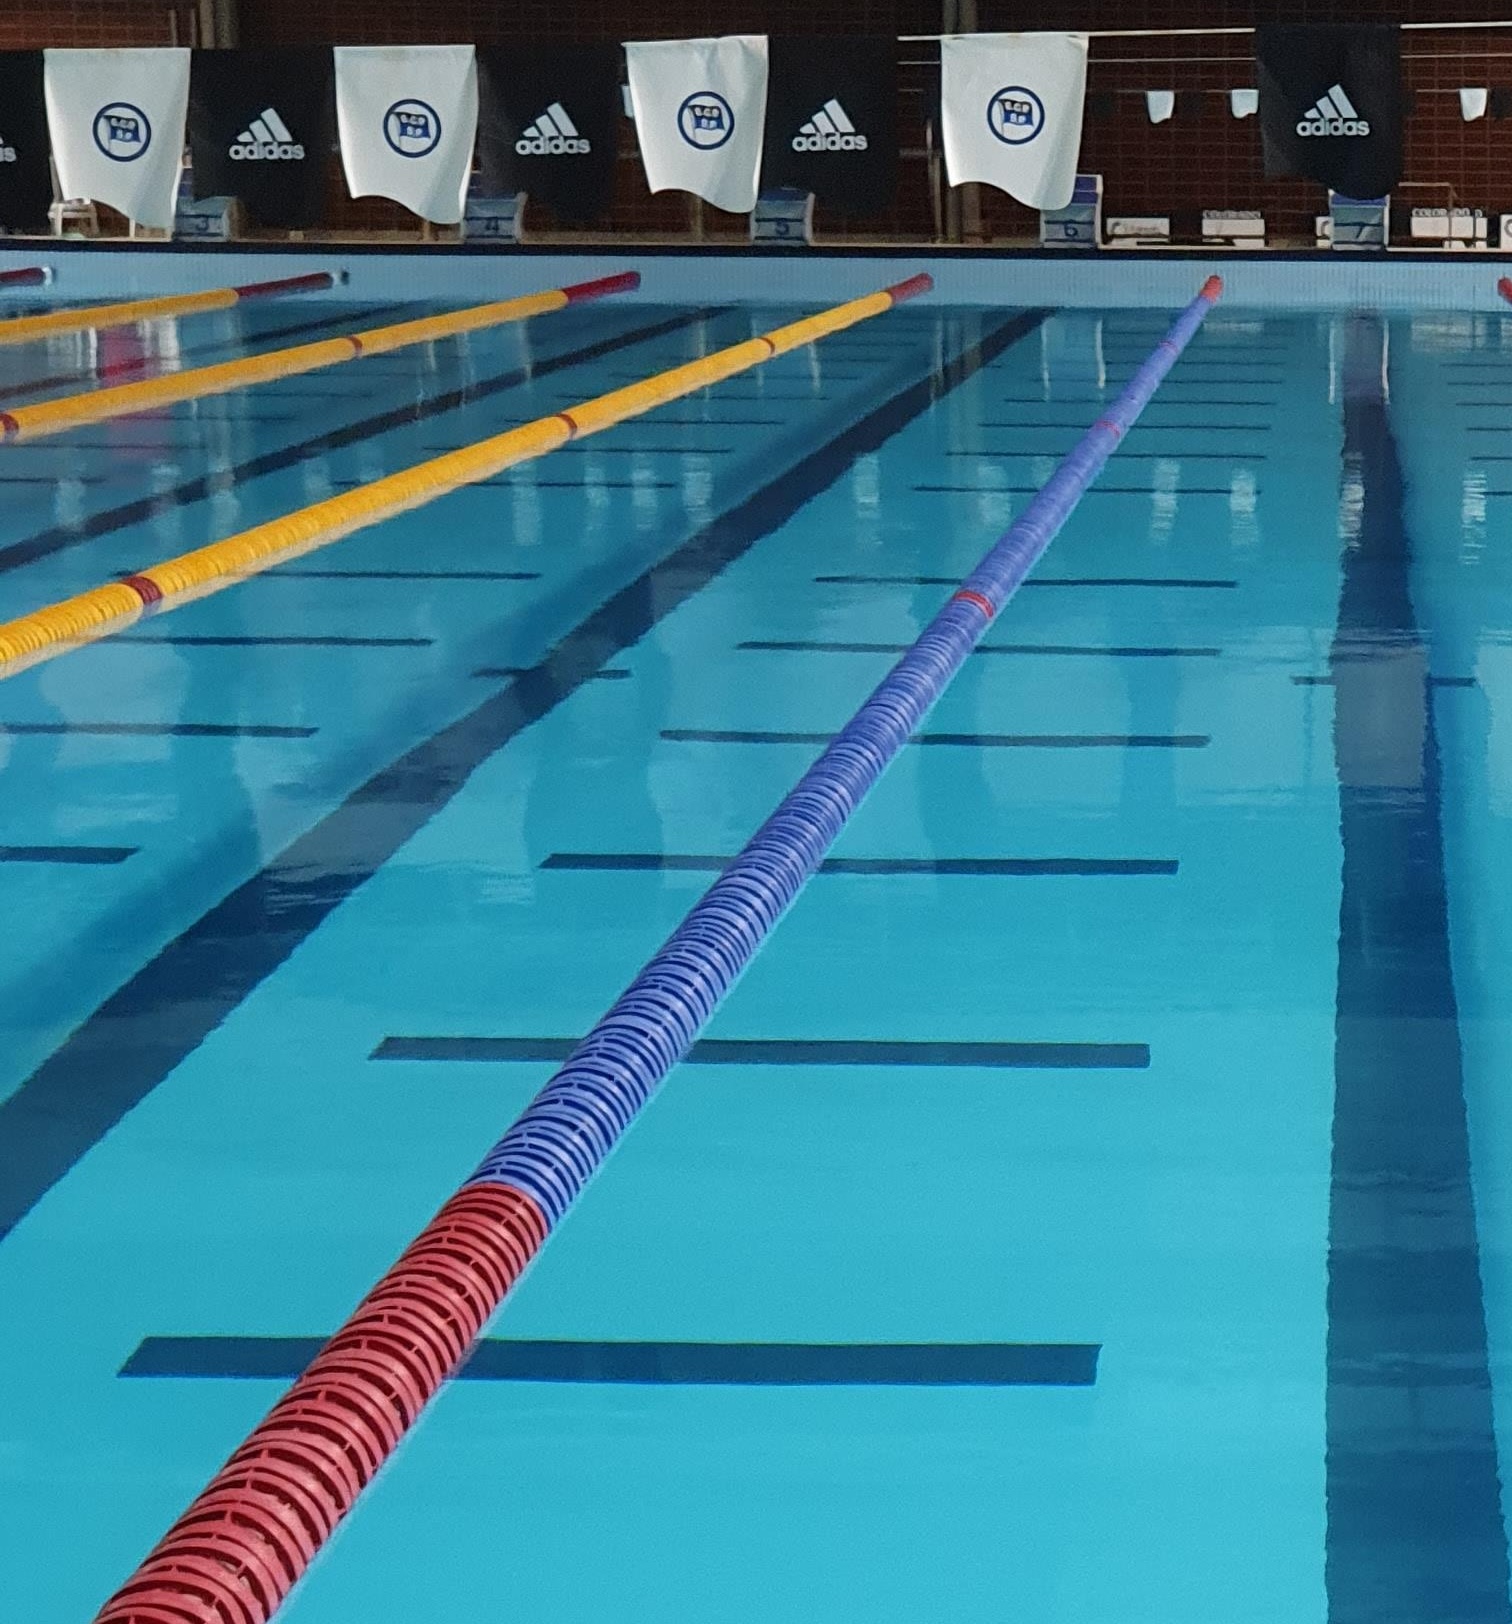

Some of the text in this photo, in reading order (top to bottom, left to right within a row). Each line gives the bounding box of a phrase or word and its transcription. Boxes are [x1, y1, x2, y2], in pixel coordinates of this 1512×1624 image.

[1297, 117, 1370, 138] adidas
[229, 141, 305, 161] adidas
[515, 136, 591, 156] adidas
[792, 132, 868, 153] adidas
[1063, 219, 1078, 237] 6
